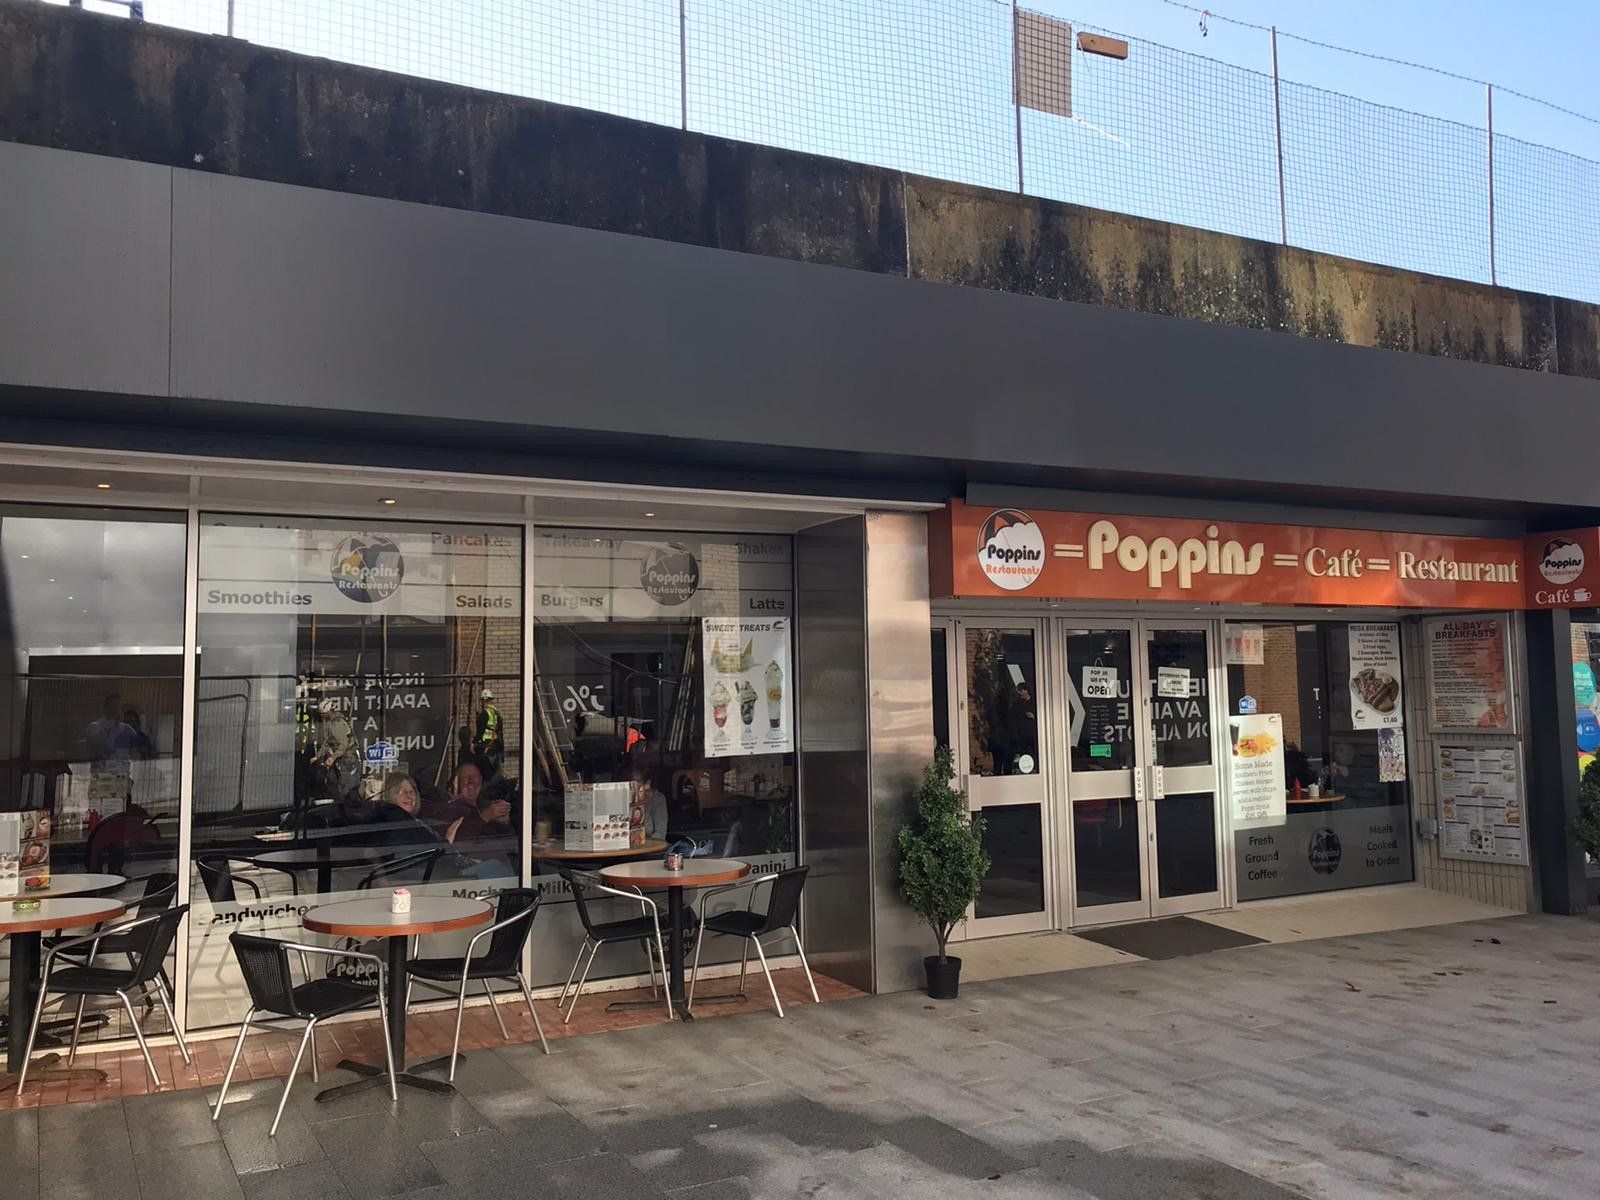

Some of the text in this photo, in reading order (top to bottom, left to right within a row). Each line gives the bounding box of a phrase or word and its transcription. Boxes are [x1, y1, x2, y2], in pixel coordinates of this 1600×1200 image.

[431, 532, 511, 547] Pancakes
[736, 542, 784, 555] Shakes
[987, 543, 1041, 563] Poppins
[1087, 519, 1519, 589] Poppins Café Restaurant
[1545, 558, 1582, 569] Poppins
[339, 563, 401, 581] Poppins
[986, 564, 1040, 576] Restaurants
[648, 570, 696, 585] Poppins
[338, 580, 399, 591] Restaurants
[207, 590, 312, 606] Smoothies
[455, 594, 513, 608] Salads
[541, 594, 604, 609] Burgers
[1535, 589, 1570, 604] Café
[749, 597, 785, 610] Latte
[705, 624, 771, 632] SWEET TREATS
[1443, 621, 1482, 630] ALL DAY
[1435, 629, 1496, 639] BREAKFASTS
[1254, 760, 1273, 768] Made
[1369, 824, 1393, 834] Meals
[1248, 835, 1274, 846] Fresh
[1367, 840, 1398, 851] Cooked
[1245, 853, 1279, 864] Ground
[1366, 856, 1400, 867] to Order
[751, 859, 786, 874] anini
[1248, 870, 1278, 881] Coffee
